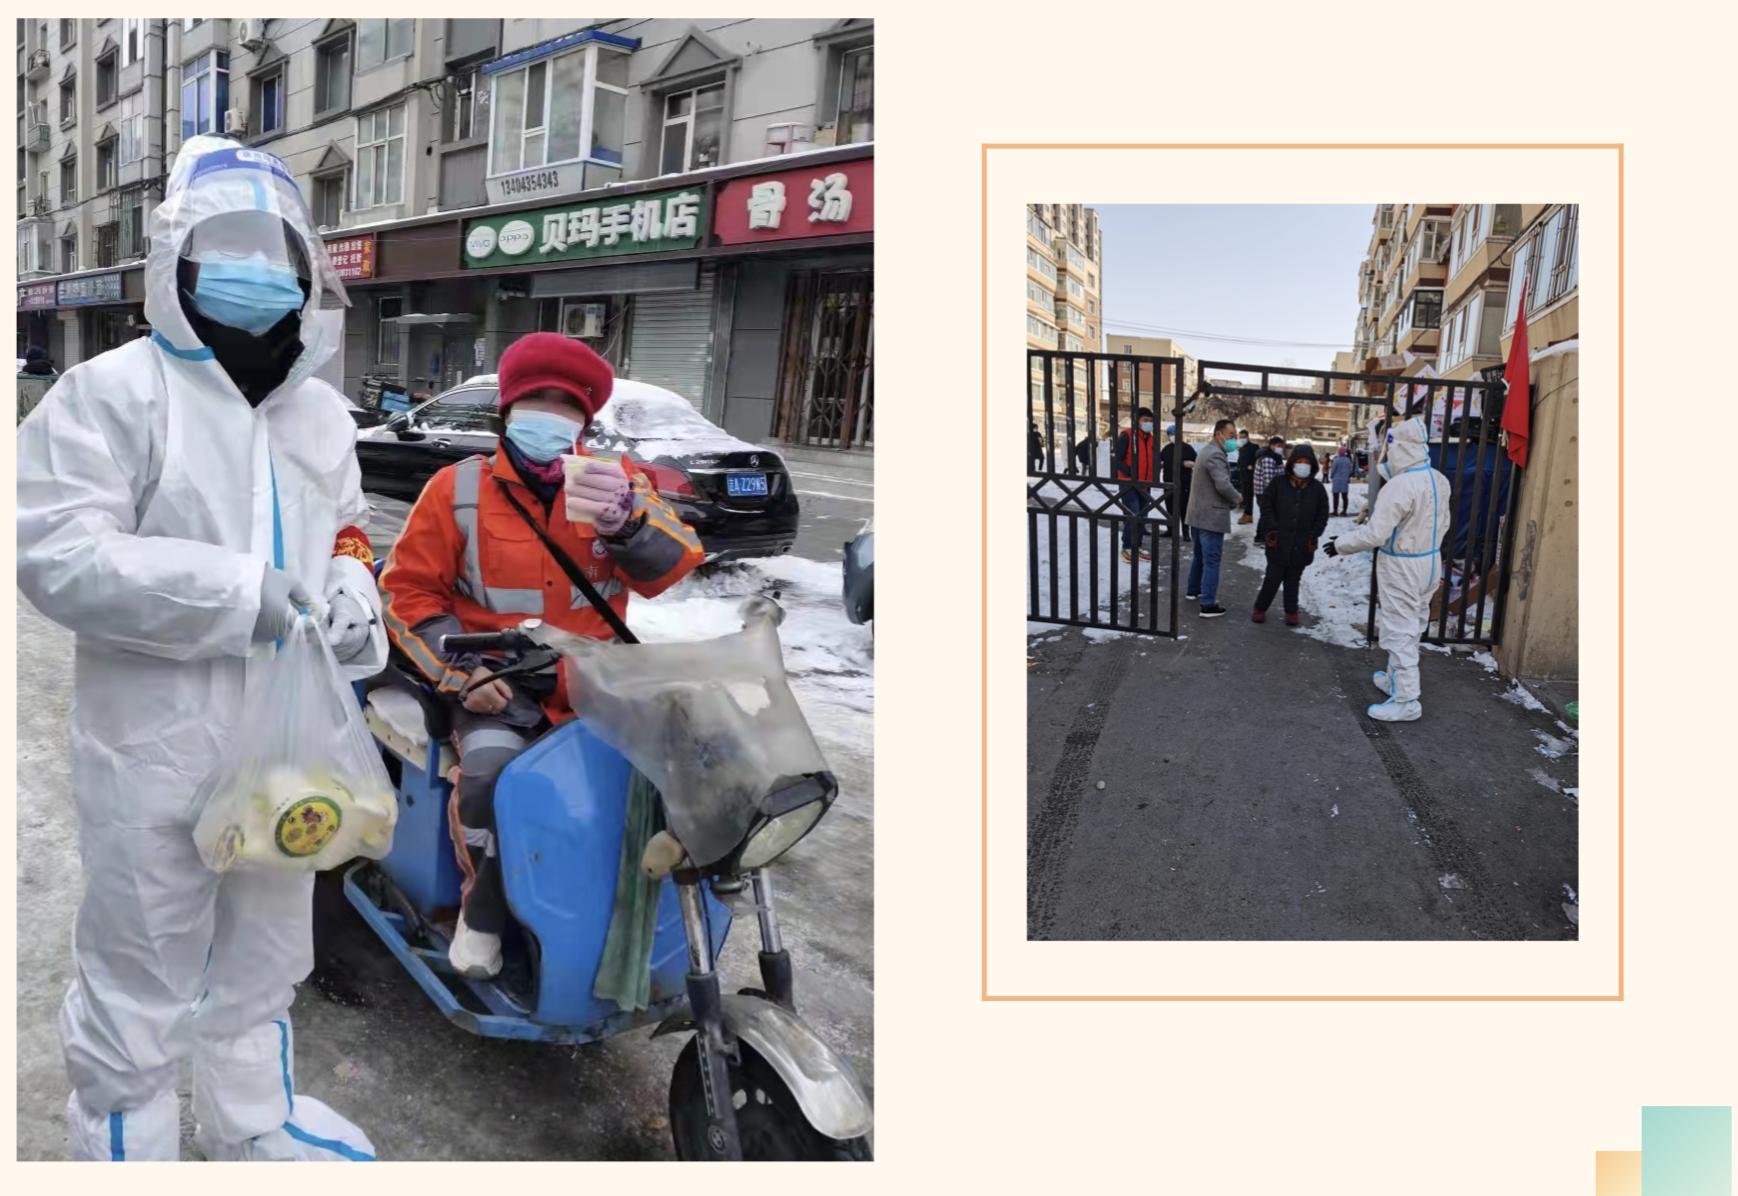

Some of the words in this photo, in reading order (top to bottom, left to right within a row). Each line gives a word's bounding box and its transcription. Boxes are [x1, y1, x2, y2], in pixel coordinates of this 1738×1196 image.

[500, 170, 559, 197] 13404354343
[538, 192, 699, 254] 贝玛手机店
